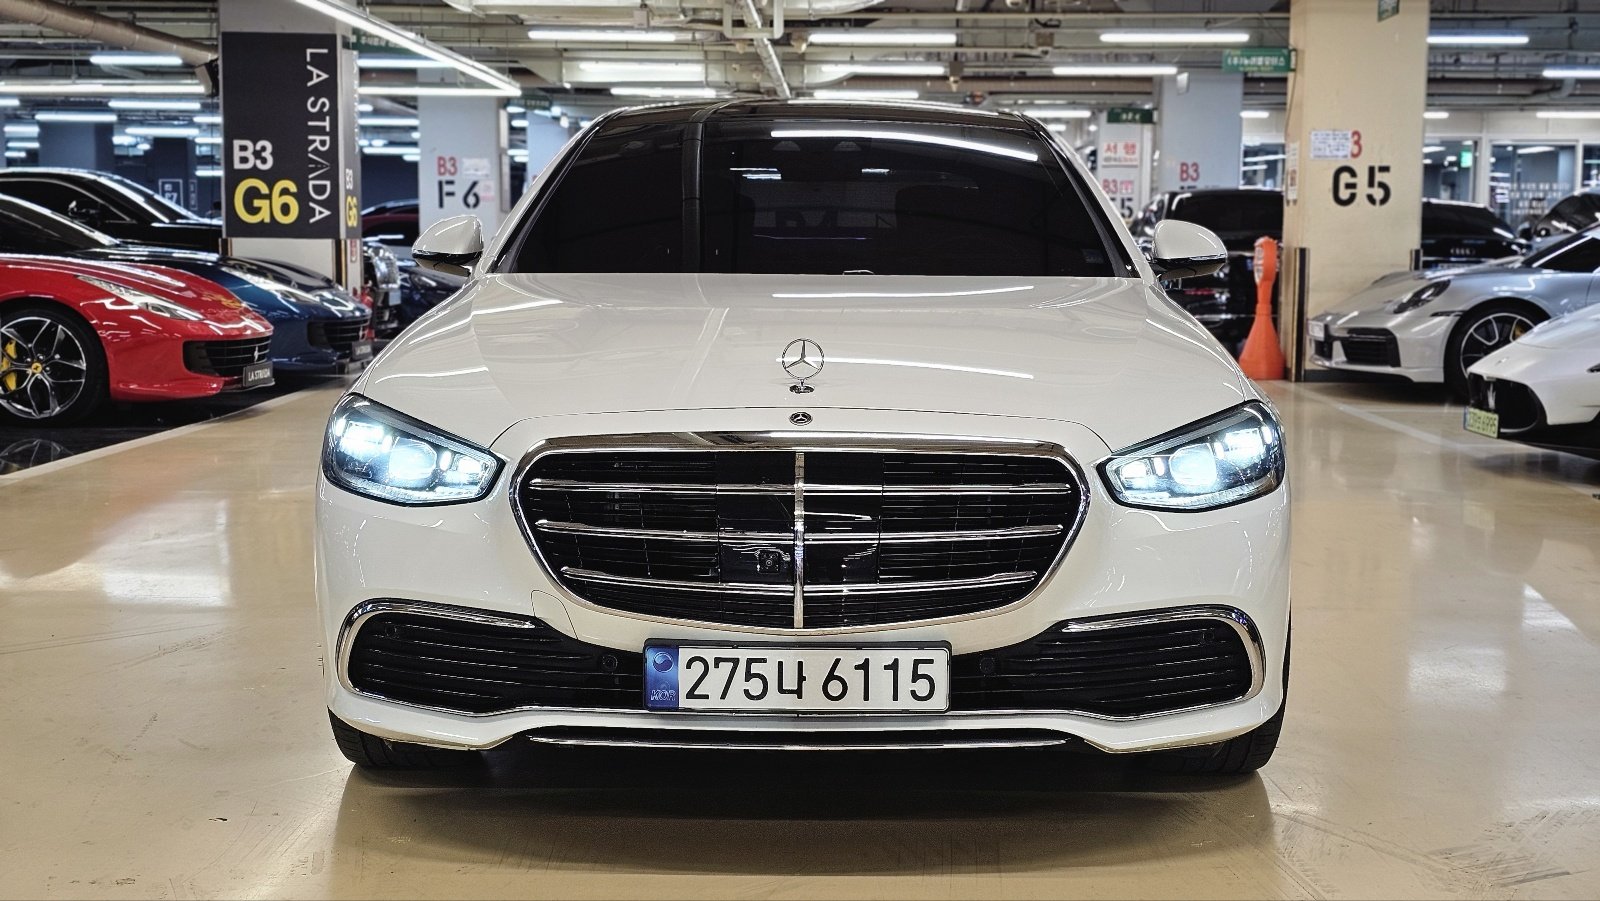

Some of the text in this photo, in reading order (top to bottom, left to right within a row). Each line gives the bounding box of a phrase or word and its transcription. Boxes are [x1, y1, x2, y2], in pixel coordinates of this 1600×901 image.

[306, 48, 332, 224] LA STRADA
[1350, 130, 1362, 158] 3
[233, 139, 273, 170] B3
[437, 156, 457, 176] B3
[1102, 179, 1118, 194] B3
[1179, 162, 1199, 182] B3
[233, 177, 299, 225] G6
[685, 655, 936, 702] 275나 6115
